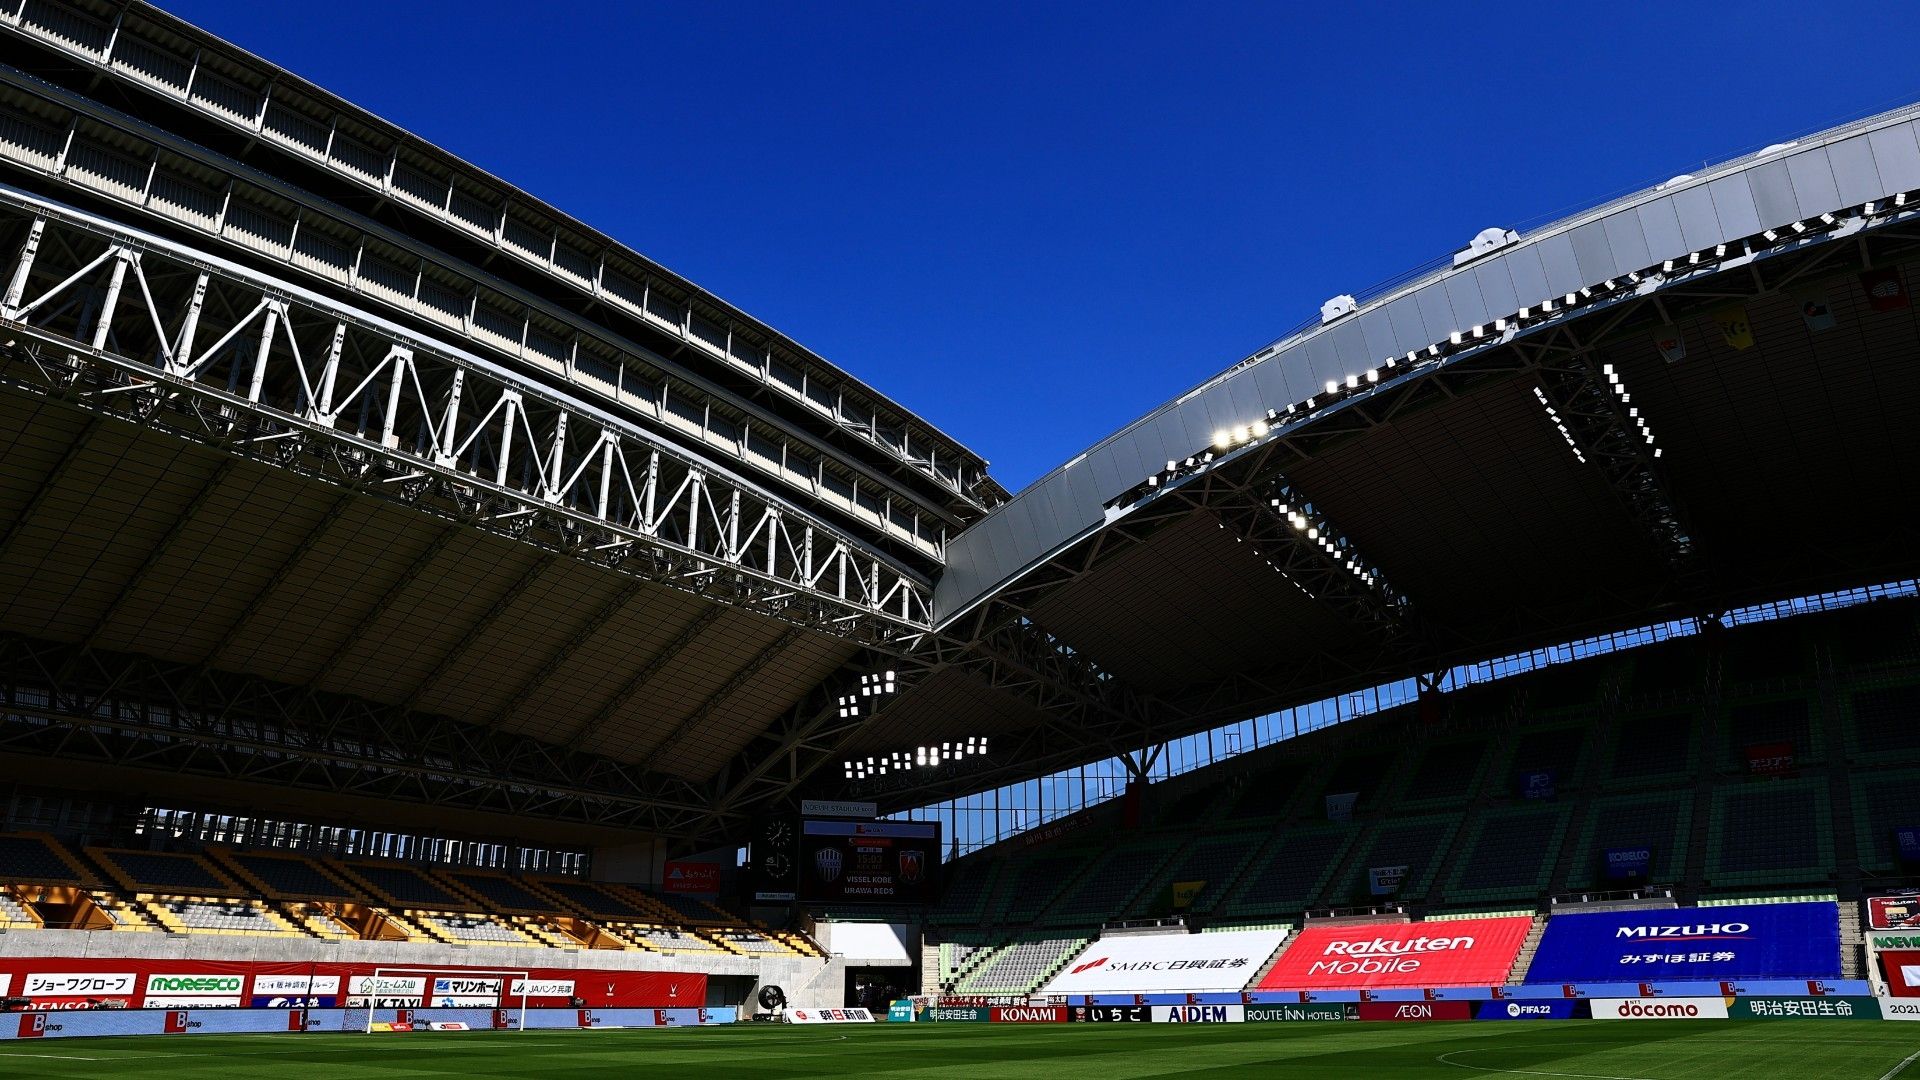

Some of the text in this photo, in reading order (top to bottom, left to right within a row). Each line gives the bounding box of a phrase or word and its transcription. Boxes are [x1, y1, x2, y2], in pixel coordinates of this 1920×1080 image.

[1608, 851, 1650, 862] KOBELCO
[1615, 922, 1750, 938] MIZUHO
[1323, 935, 1474, 957] Rakuten
[1105, 957, 1249, 972] SMBC日興証券
[1619, 951, 1736, 964] みずほ証券
[1308, 956, 1421, 975] Mobile
[31, 977, 129, 992] ショーワグローブ
[150, 977, 241, 991] MORESCO
[819, 1008, 869, 1021] 朝日新聞
[929, 1009, 978, 1020] 明治安田生命
[1000, 1007, 1056, 1021] KONAMI
[1091, 1007, 1142, 1022] いちご
[1247, 1009, 1282, 1021] ROUTE
[1307, 1011, 1341, 1021] HOTELS
[1618, 1000, 1698, 1017] docomo
[1750, 1000, 1853, 1016] 明治安田生命
